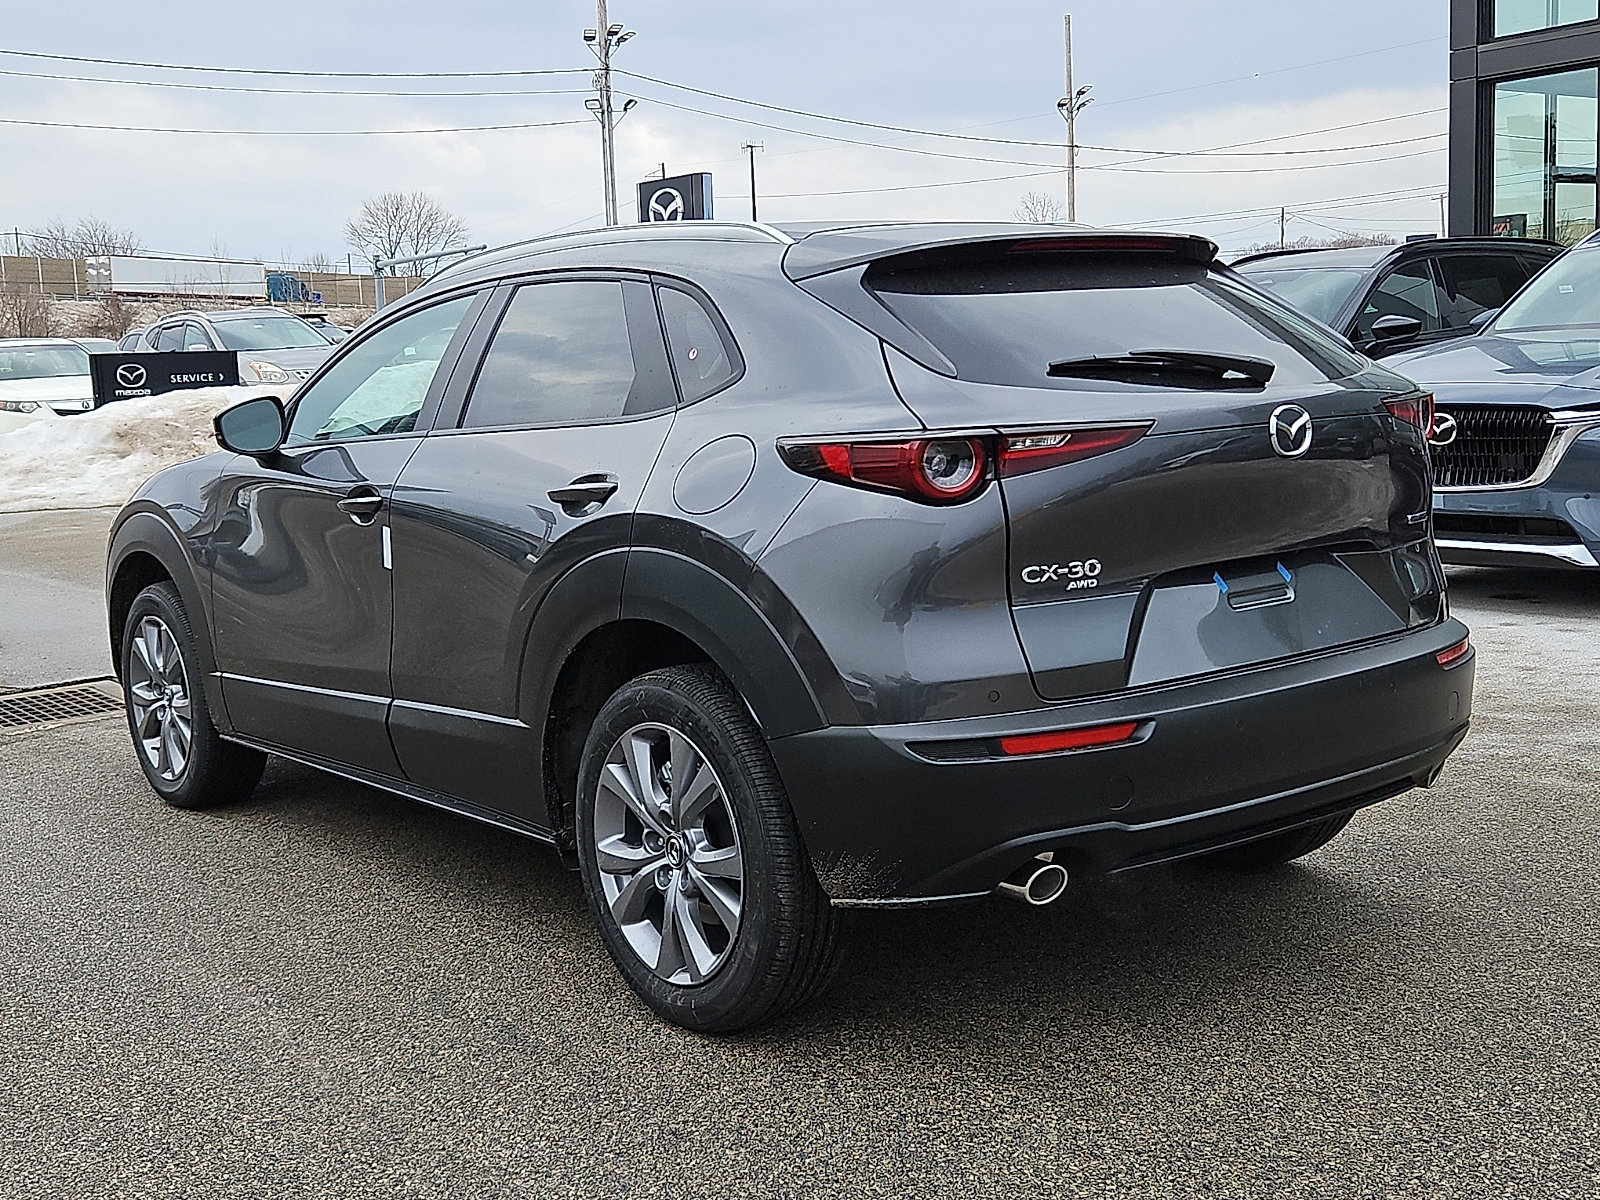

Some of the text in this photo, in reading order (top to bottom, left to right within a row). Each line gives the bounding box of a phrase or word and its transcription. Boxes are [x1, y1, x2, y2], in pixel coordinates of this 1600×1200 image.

[170, 373, 215, 383] SERVICE
[1021, 559, 1102, 583] CX-30
[1066, 579, 1098, 591] AWD
